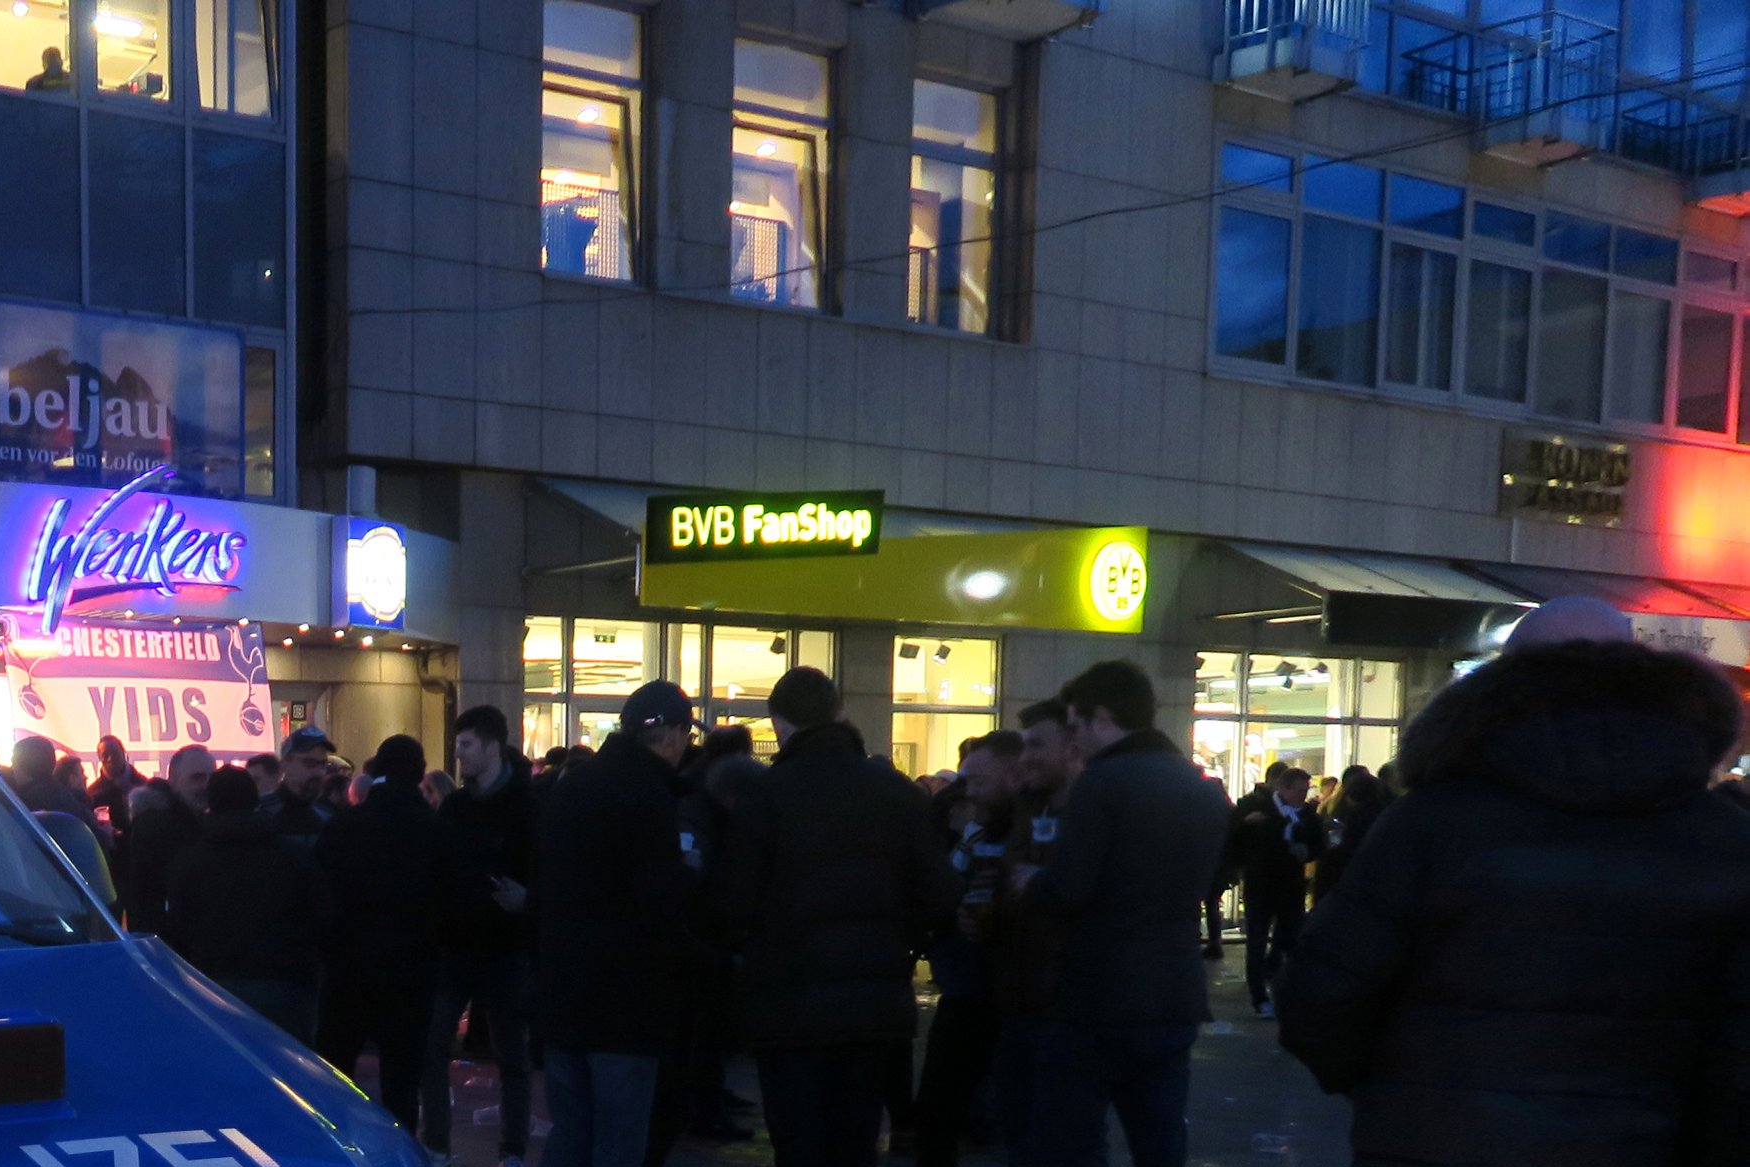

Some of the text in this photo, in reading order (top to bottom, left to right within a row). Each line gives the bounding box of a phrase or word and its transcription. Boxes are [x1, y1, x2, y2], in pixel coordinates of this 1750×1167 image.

[26, 446, 57, 464] vor
[101, 451, 164, 474] Lofote
[671, 503, 872, 548] BVB FanShop
[28, 464, 247, 634] Wenkers
[53, 626, 222, 662] CHESTERFIELD
[87, 686, 212, 743] YIDS
